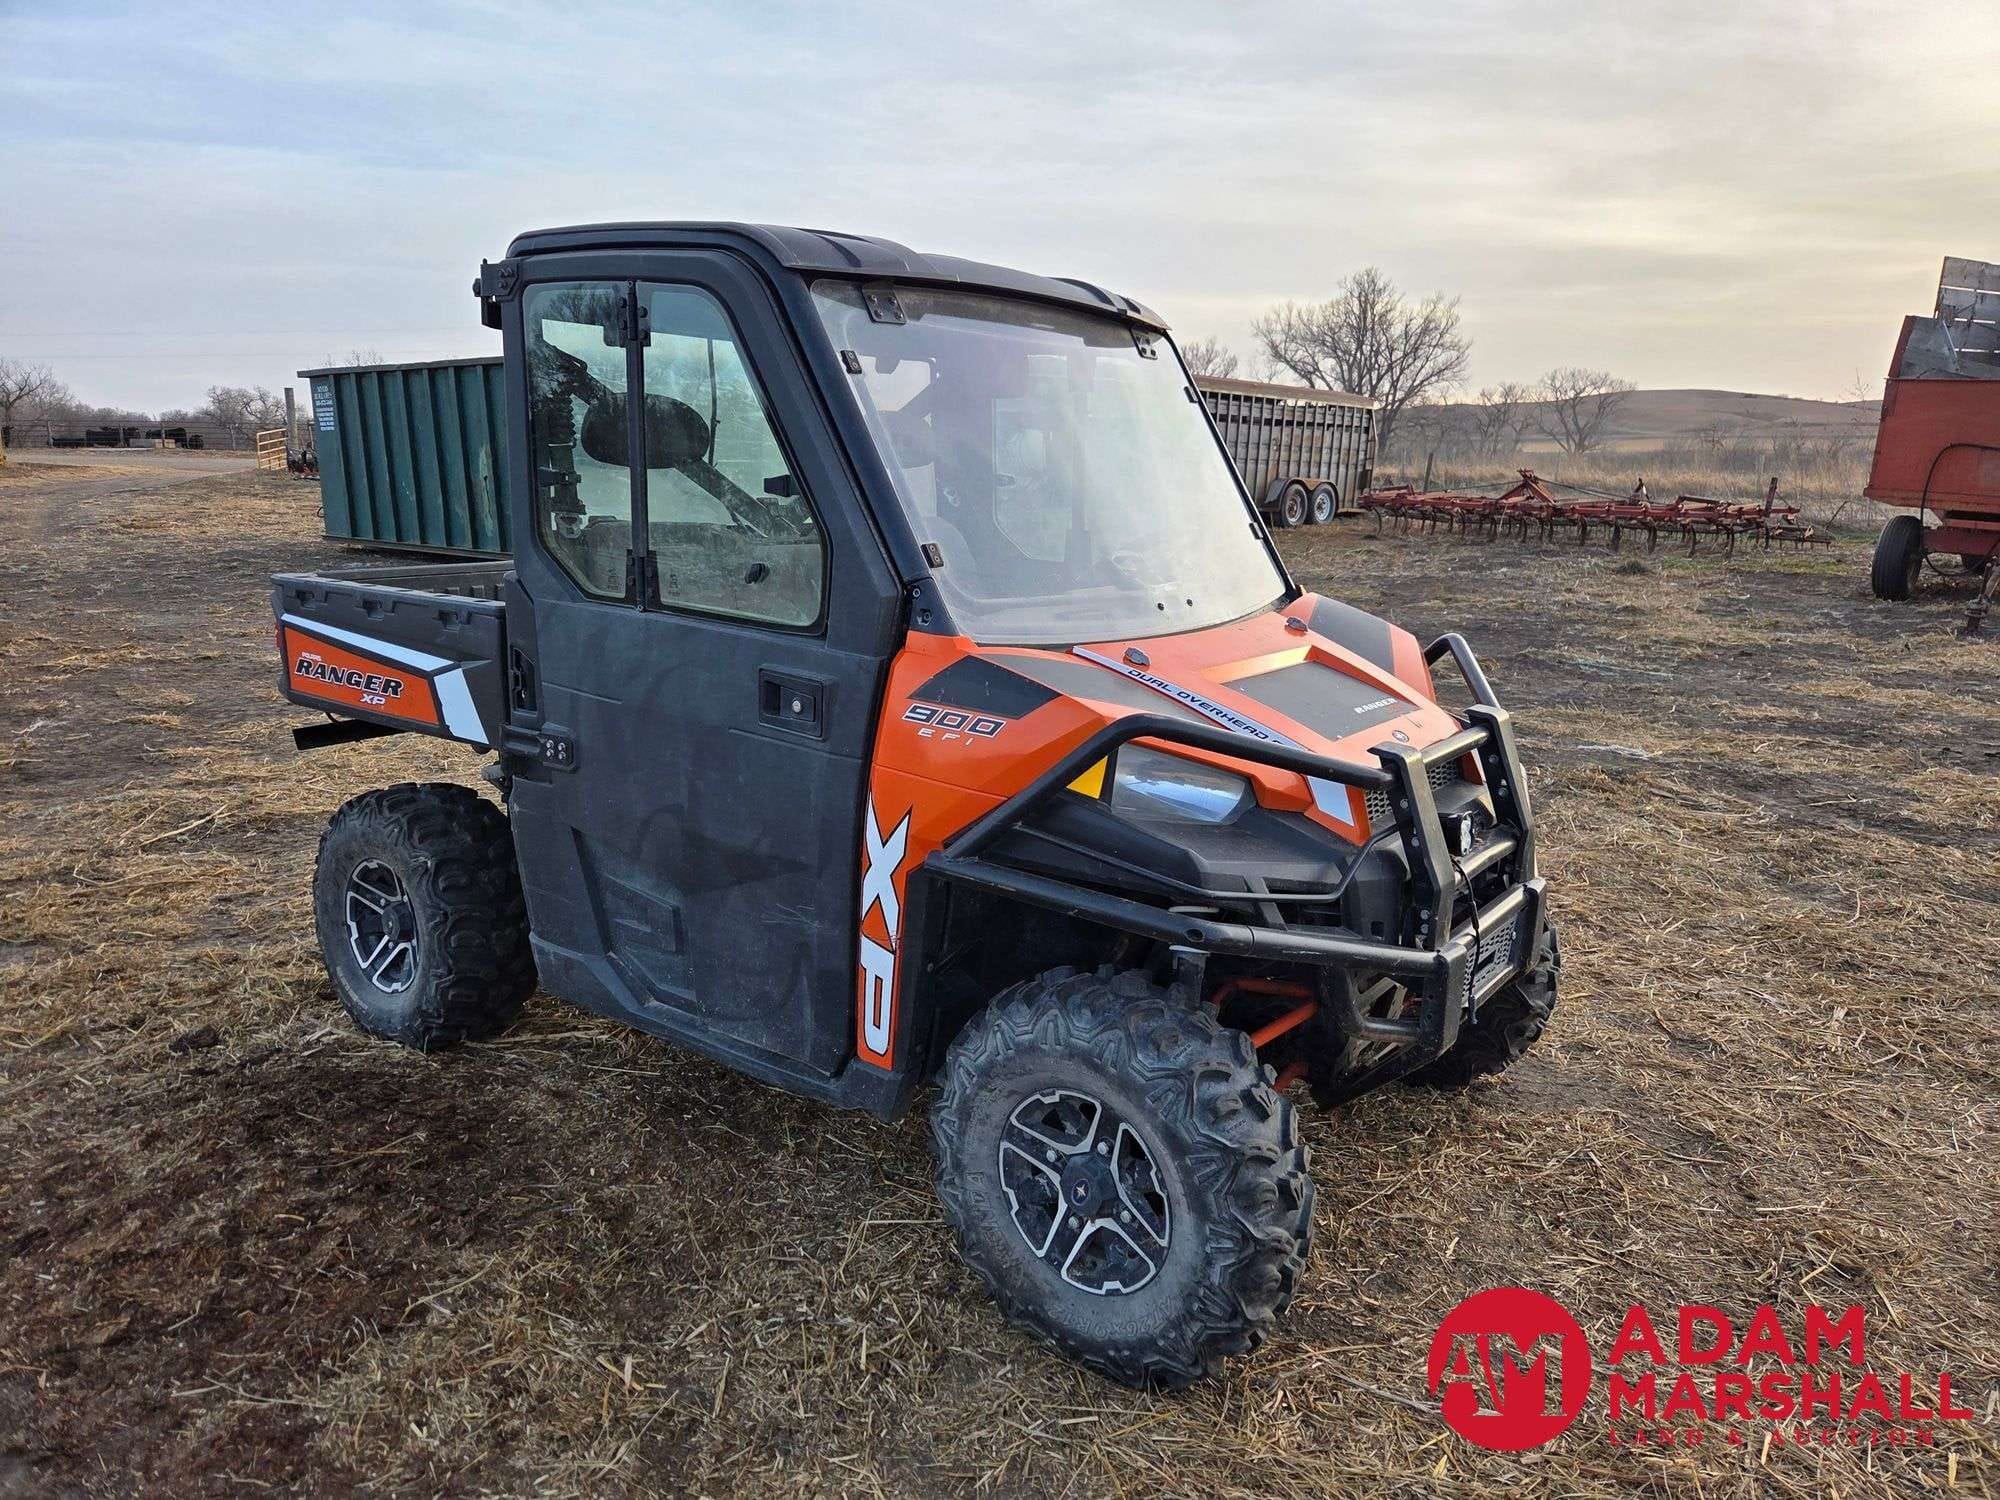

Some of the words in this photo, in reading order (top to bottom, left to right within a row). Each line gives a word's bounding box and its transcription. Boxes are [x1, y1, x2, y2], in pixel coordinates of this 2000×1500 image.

[295, 658, 405, 698] RANGER
[359, 692, 386, 706] XP
[1127, 669, 1173, 693] DUAL
[1176, 690, 1269, 740] OVERHEAD
[1353, 697, 1398, 714] RANGER
[901, 703, 1007, 738] 900
[917, 727, 974, 746] EFI
[859, 790, 912, 1057] XP
